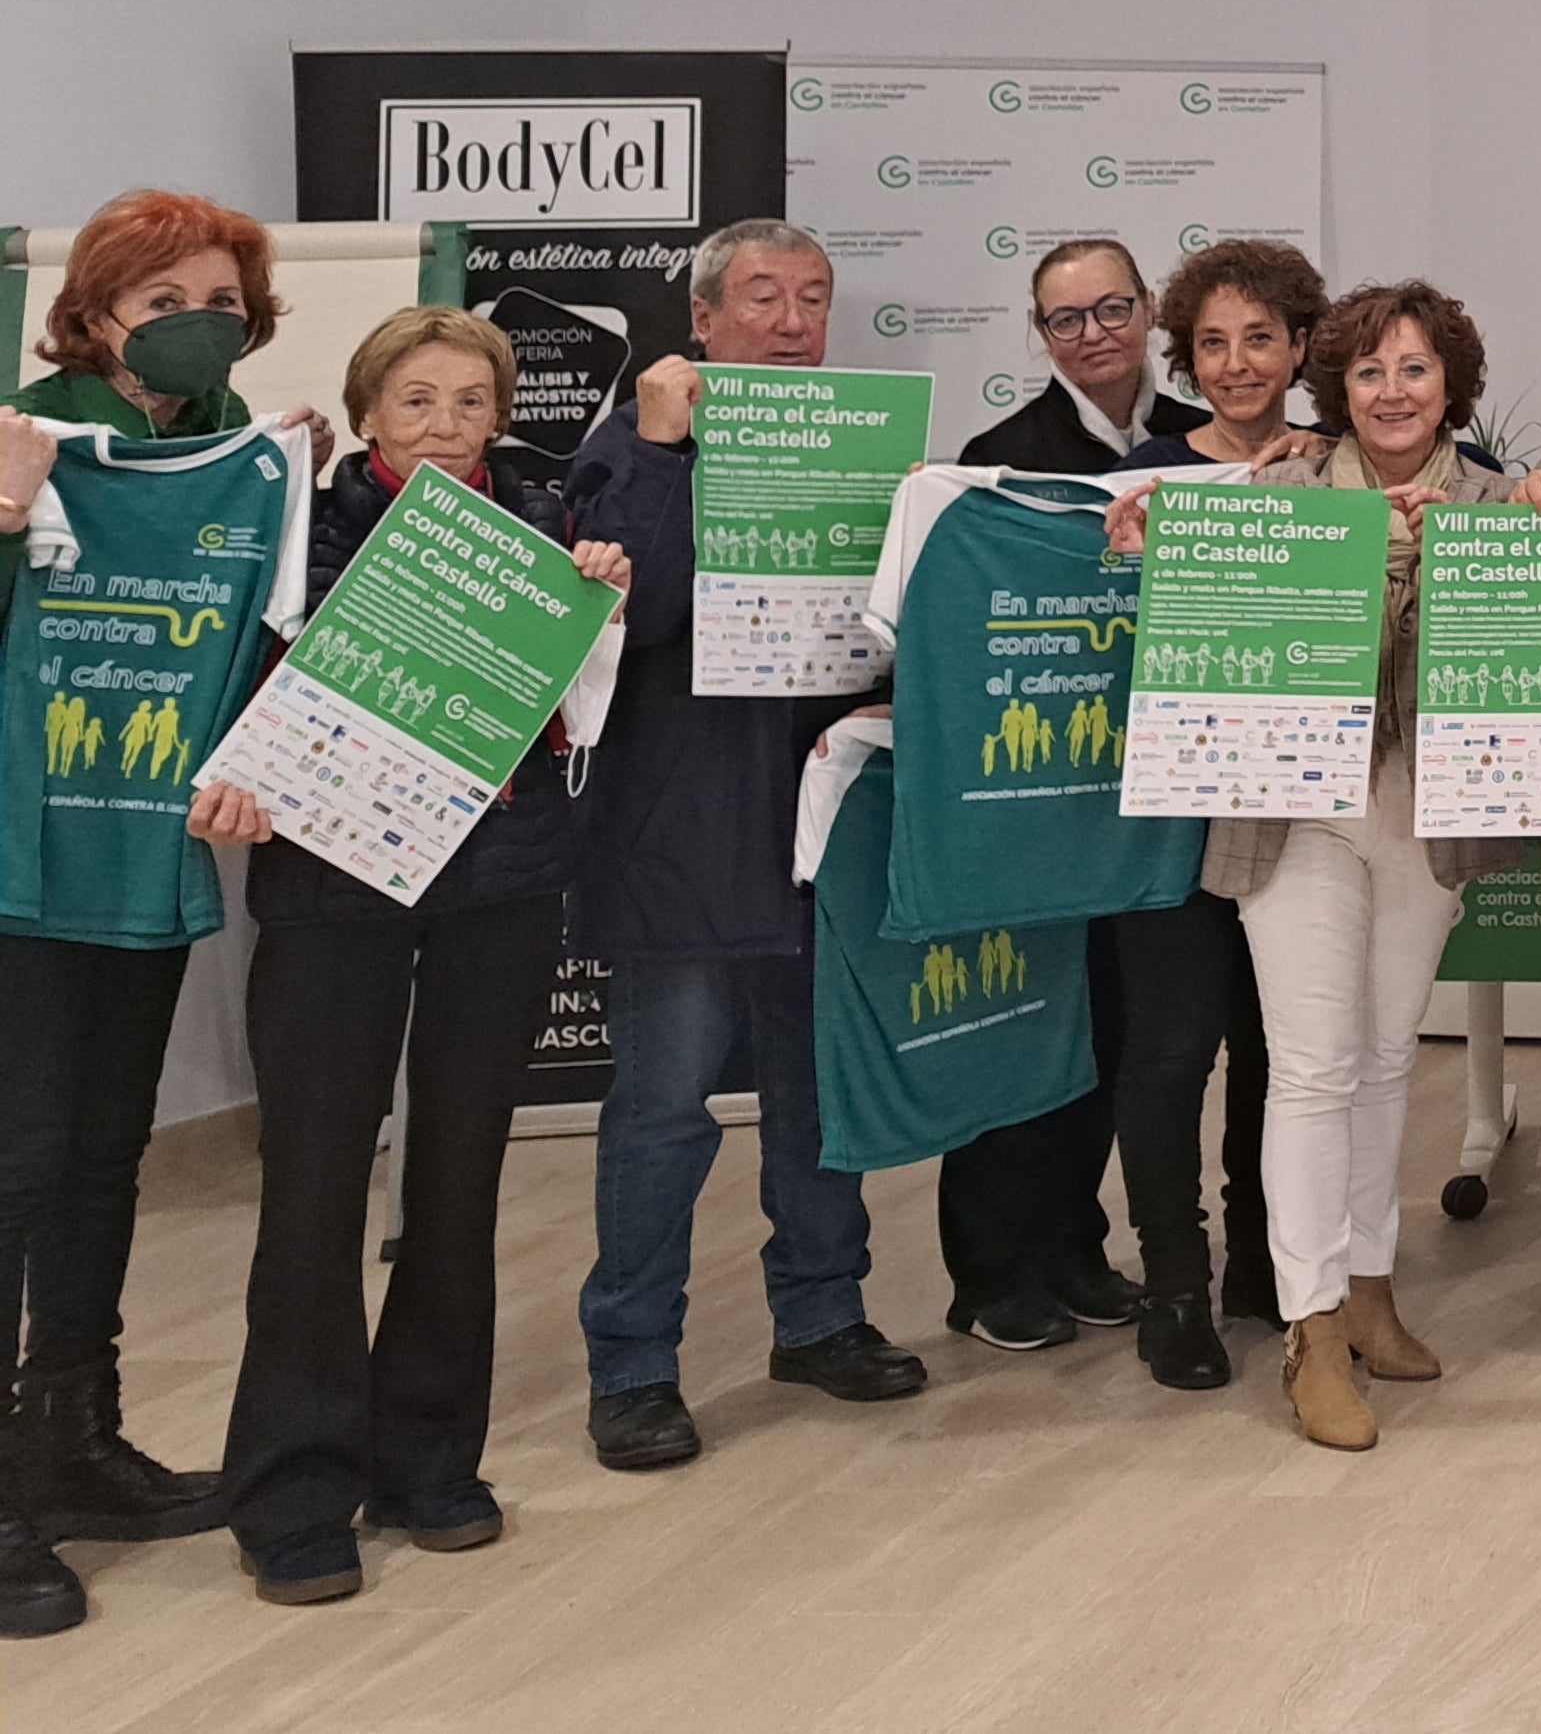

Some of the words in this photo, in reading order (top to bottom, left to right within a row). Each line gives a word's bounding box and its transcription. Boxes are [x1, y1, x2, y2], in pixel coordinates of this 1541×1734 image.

[411, 117, 669, 213] BodyCel
[508, 241, 613, 271] estética
[618, 241, 699, 283] integr
[508, 325, 593, 345] OMOCIÓN
[515, 345, 564, 361] FERIA
[516, 370, 573, 387] ÁLISIS
[576, 371, 590, 386] Y
[706, 376, 743, 396] VIII
[749, 380, 835, 401] marcha
[510, 406, 586, 422] RATUITO
[704, 403, 778, 422] contra
[783, 404, 806, 424] el
[810, 405, 891, 426] cáncer
[704, 429, 732, 445] en
[737, 426, 832, 449] Castelló
[1161, 491, 1199, 512] VIII
[1204, 494, 1294, 515] marcha
[421, 479, 459, 516] VIII
[456, 509, 537, 568] marcha
[1158, 517, 1235, 537] contra
[1240, 518, 1264, 539] el
[1268, 520, 1350, 541] cáncer
[1434, 512, 1469, 532] VIII
[1156, 544, 1186, 561] en
[1192, 542, 1291, 565] Castelló
[1433, 537, 1504, 557] contra
[1509, 537, 1532, 557] el
[386, 530, 418, 558] en
[419, 547, 507, 613] Castelló
[402, 507, 474, 561] contra
[474, 553, 501, 576] el
[498, 567, 572, 619] cáncer
[1432, 566, 1460, 582] en
[47, 565, 96, 595] En
[106, 573, 232, 604] marcha
[991, 590, 1027, 616] En
[1036, 588, 1139, 615] marcha
[39, 616, 157, 645] contra
[988, 632, 1080, 656] contra
[70, 659, 193, 694] cáncer
[986, 668, 1013, 696] el
[1020, 669, 1115, 695] cáncer
[1477, 890, 1531, 905] contra
[1477, 914, 1498, 926] en
